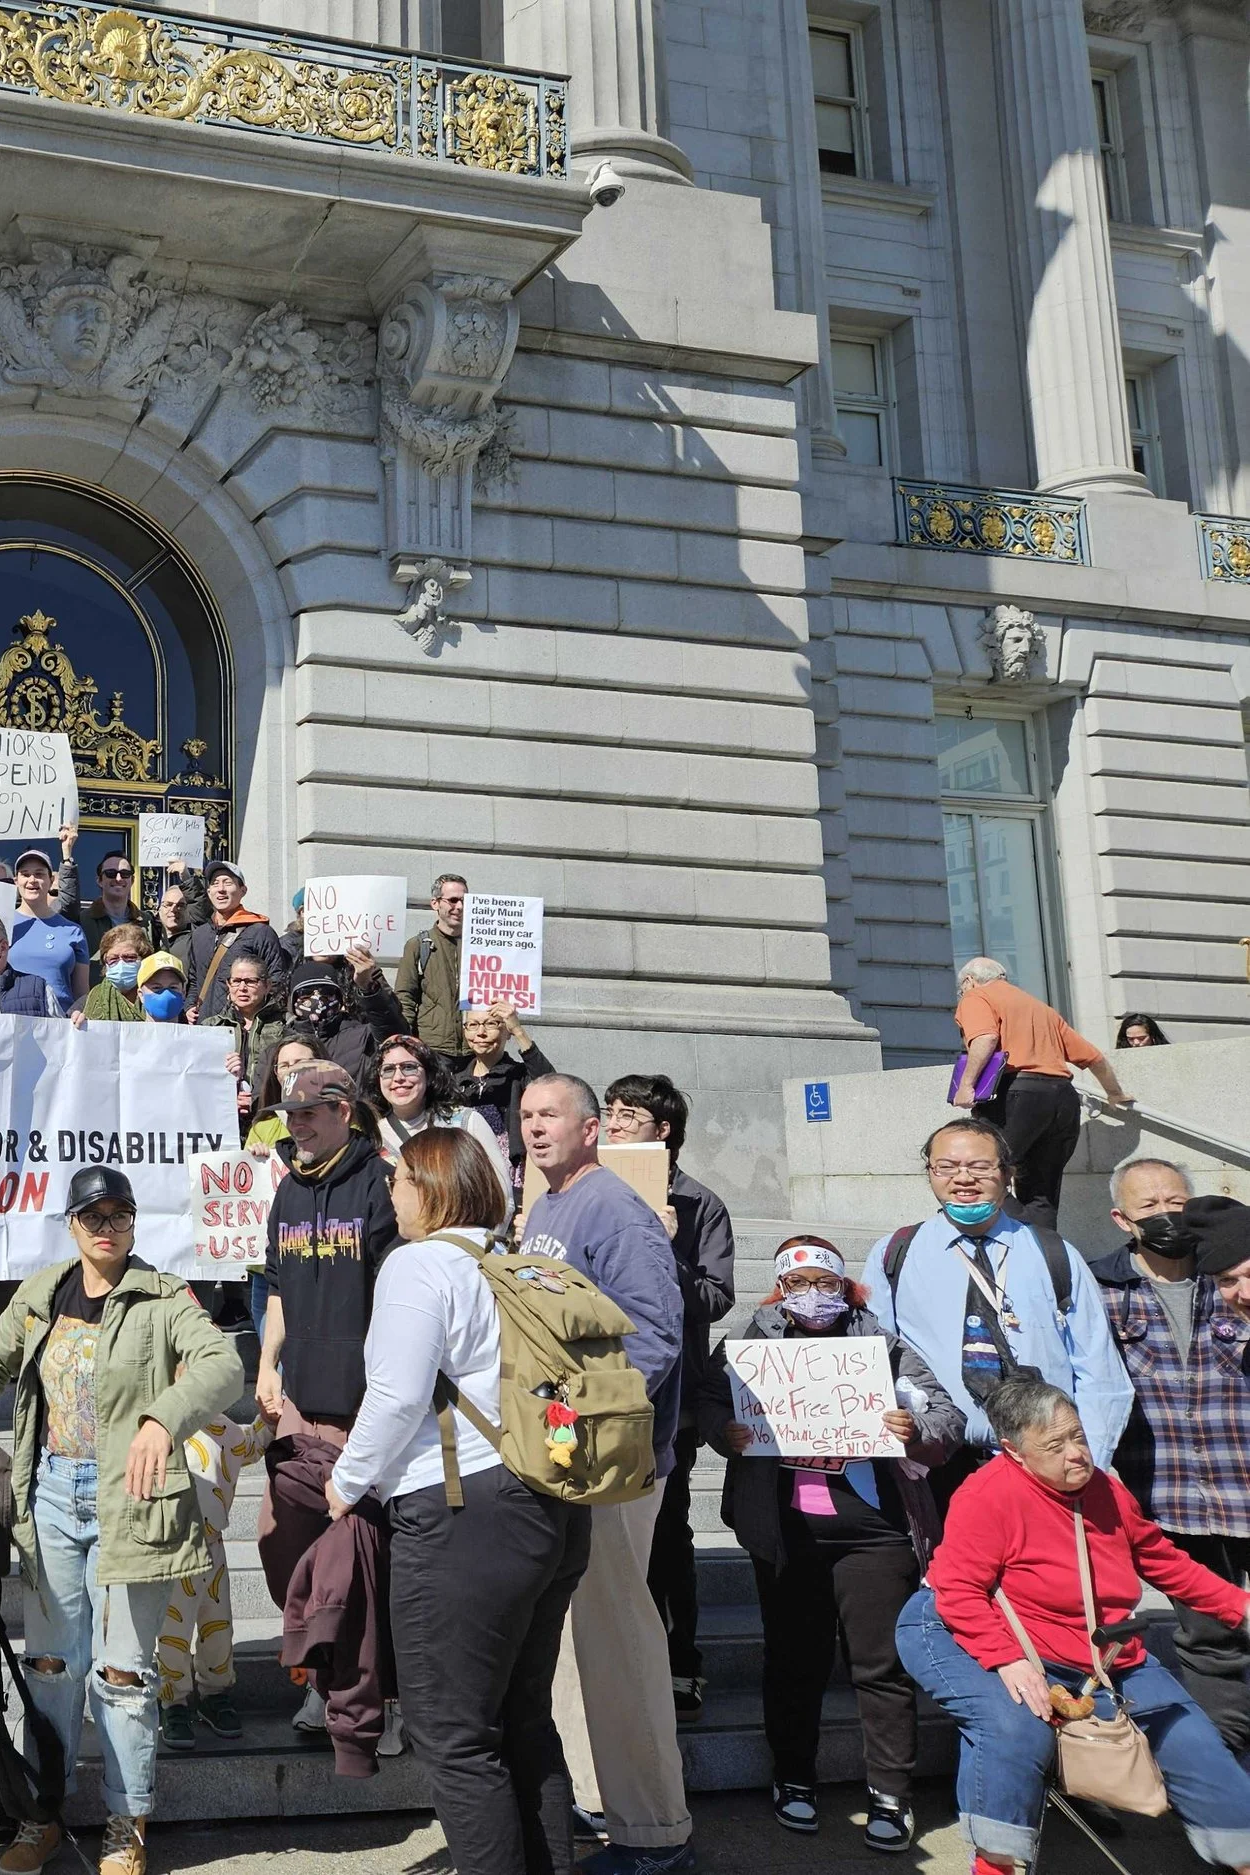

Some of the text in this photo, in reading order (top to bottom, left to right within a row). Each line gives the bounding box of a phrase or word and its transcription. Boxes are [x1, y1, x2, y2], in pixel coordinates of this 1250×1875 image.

[307, 885, 337, 912] NO
[472, 896, 525, 908] I've been a
[471, 906, 523, 918] daily Muni
[471, 916, 525, 928] rider since
[470, 926, 534, 939] I sold my car
[470, 936, 537, 950] 28 years ago.
[469, 953, 502, 973] NO
[468, 971, 530, 992] MUNI
[467, 987, 536, 1010] CUTS!
[28, 1129, 49, 1163] &
[57, 1130, 223, 1165] DISABILITY
[200, 1160, 254, 1196] NO
[735, 1344, 829, 1391] SAVE
